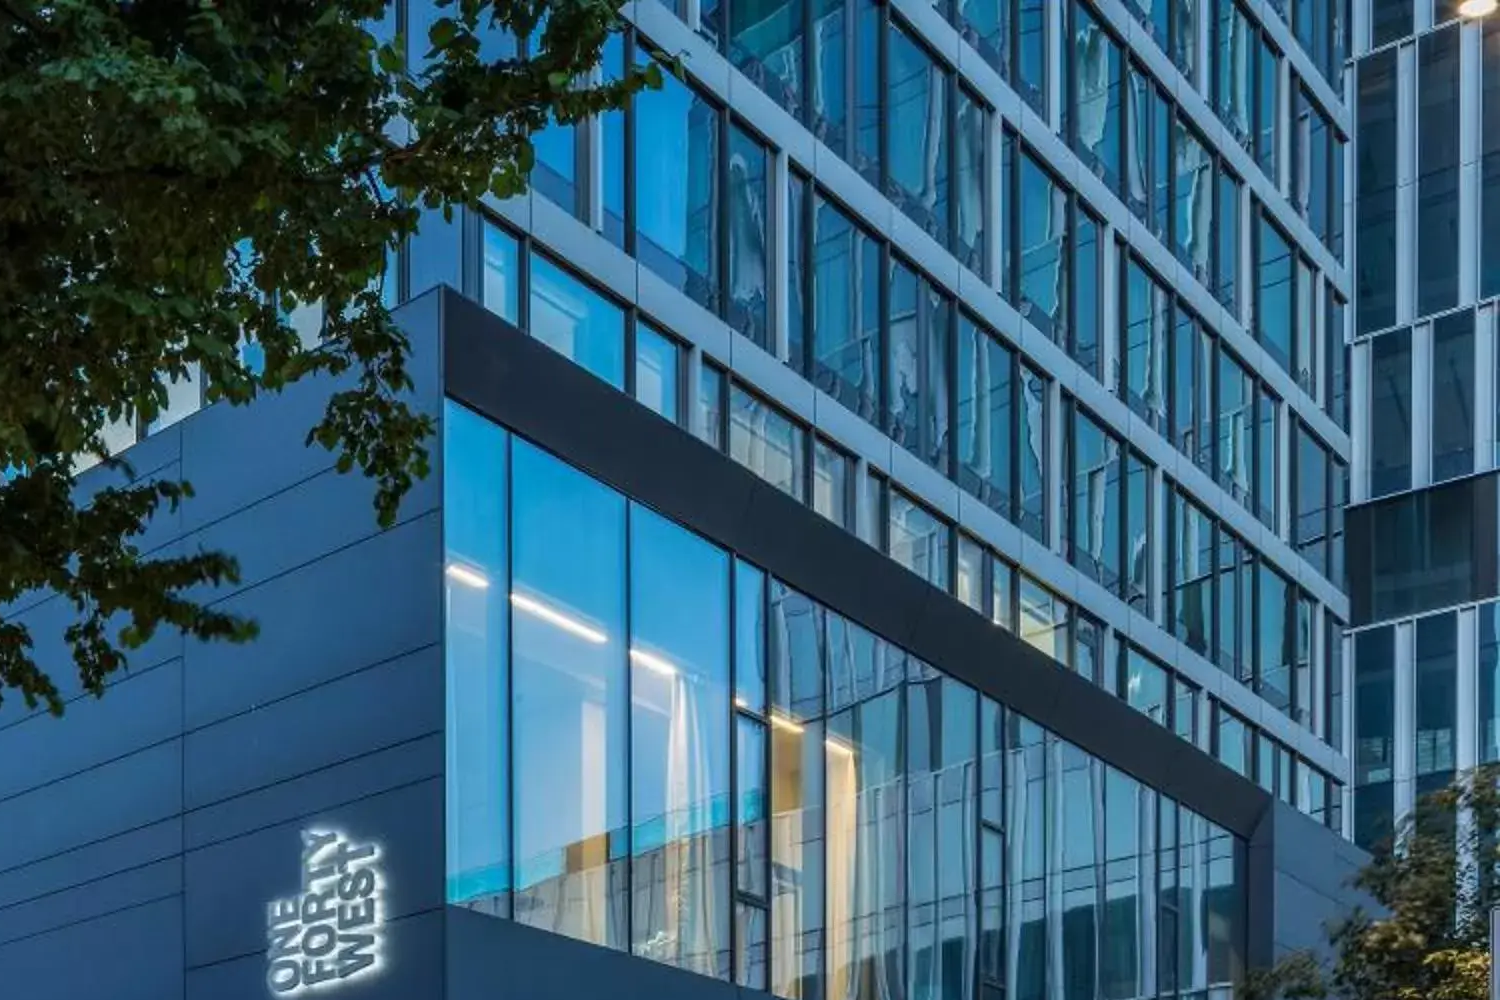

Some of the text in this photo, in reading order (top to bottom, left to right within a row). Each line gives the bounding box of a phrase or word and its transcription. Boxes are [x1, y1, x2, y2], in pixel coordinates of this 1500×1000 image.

[269, 898, 301, 993] ONE
[301, 831, 337, 987] FORTY
[337, 842, 375, 979] WEST
